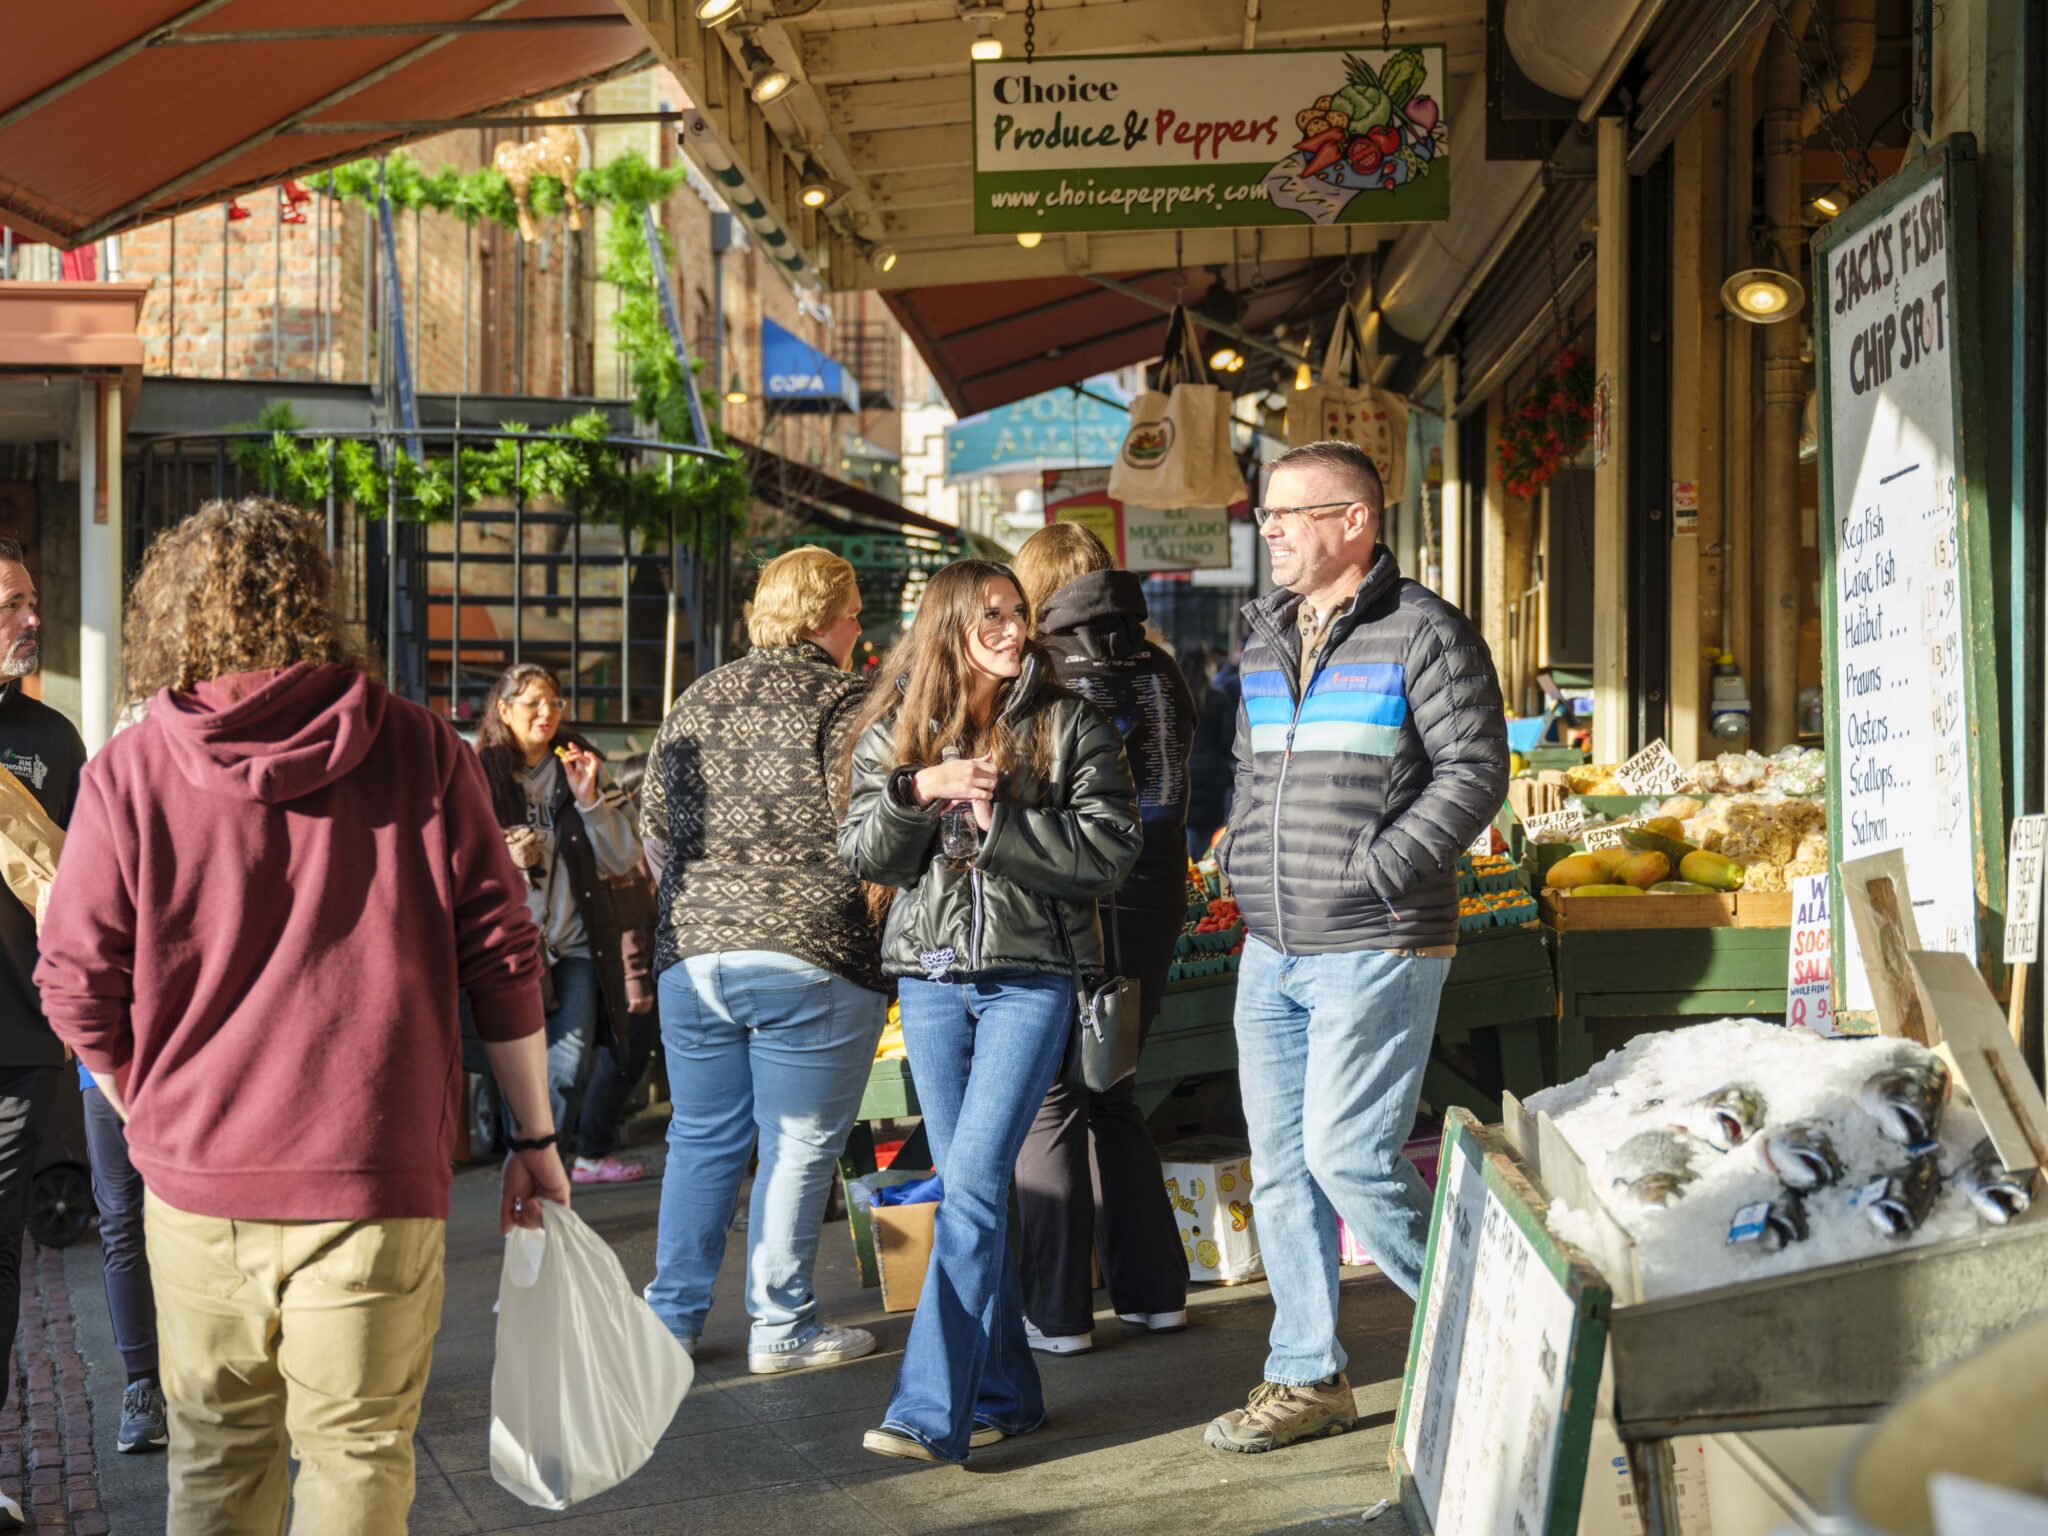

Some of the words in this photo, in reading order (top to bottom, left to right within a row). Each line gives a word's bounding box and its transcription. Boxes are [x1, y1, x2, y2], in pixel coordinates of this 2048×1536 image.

[993, 73, 1119, 105] Choice
[993, 109, 1120, 152] Produce
[1154, 107, 1279, 159] Peppers
[990, 177, 1268, 218] www.choicepeppers.com
[768, 374, 825, 393] COPA
[992, 424, 1124, 458] ALLEY
[1128, 521, 1225, 540] MERCADO
[1142, 543, 1213, 559] LATINO
[1844, 563, 1873, 608] Large
[1875, 549, 1895, 587] Fish
[1845, 603, 1882, 649] Halibut
[1846, 662, 1881, 699] Prawns
[1848, 710, 1888, 762] Oysters
[1852, 810, 1888, 846] Salmon
